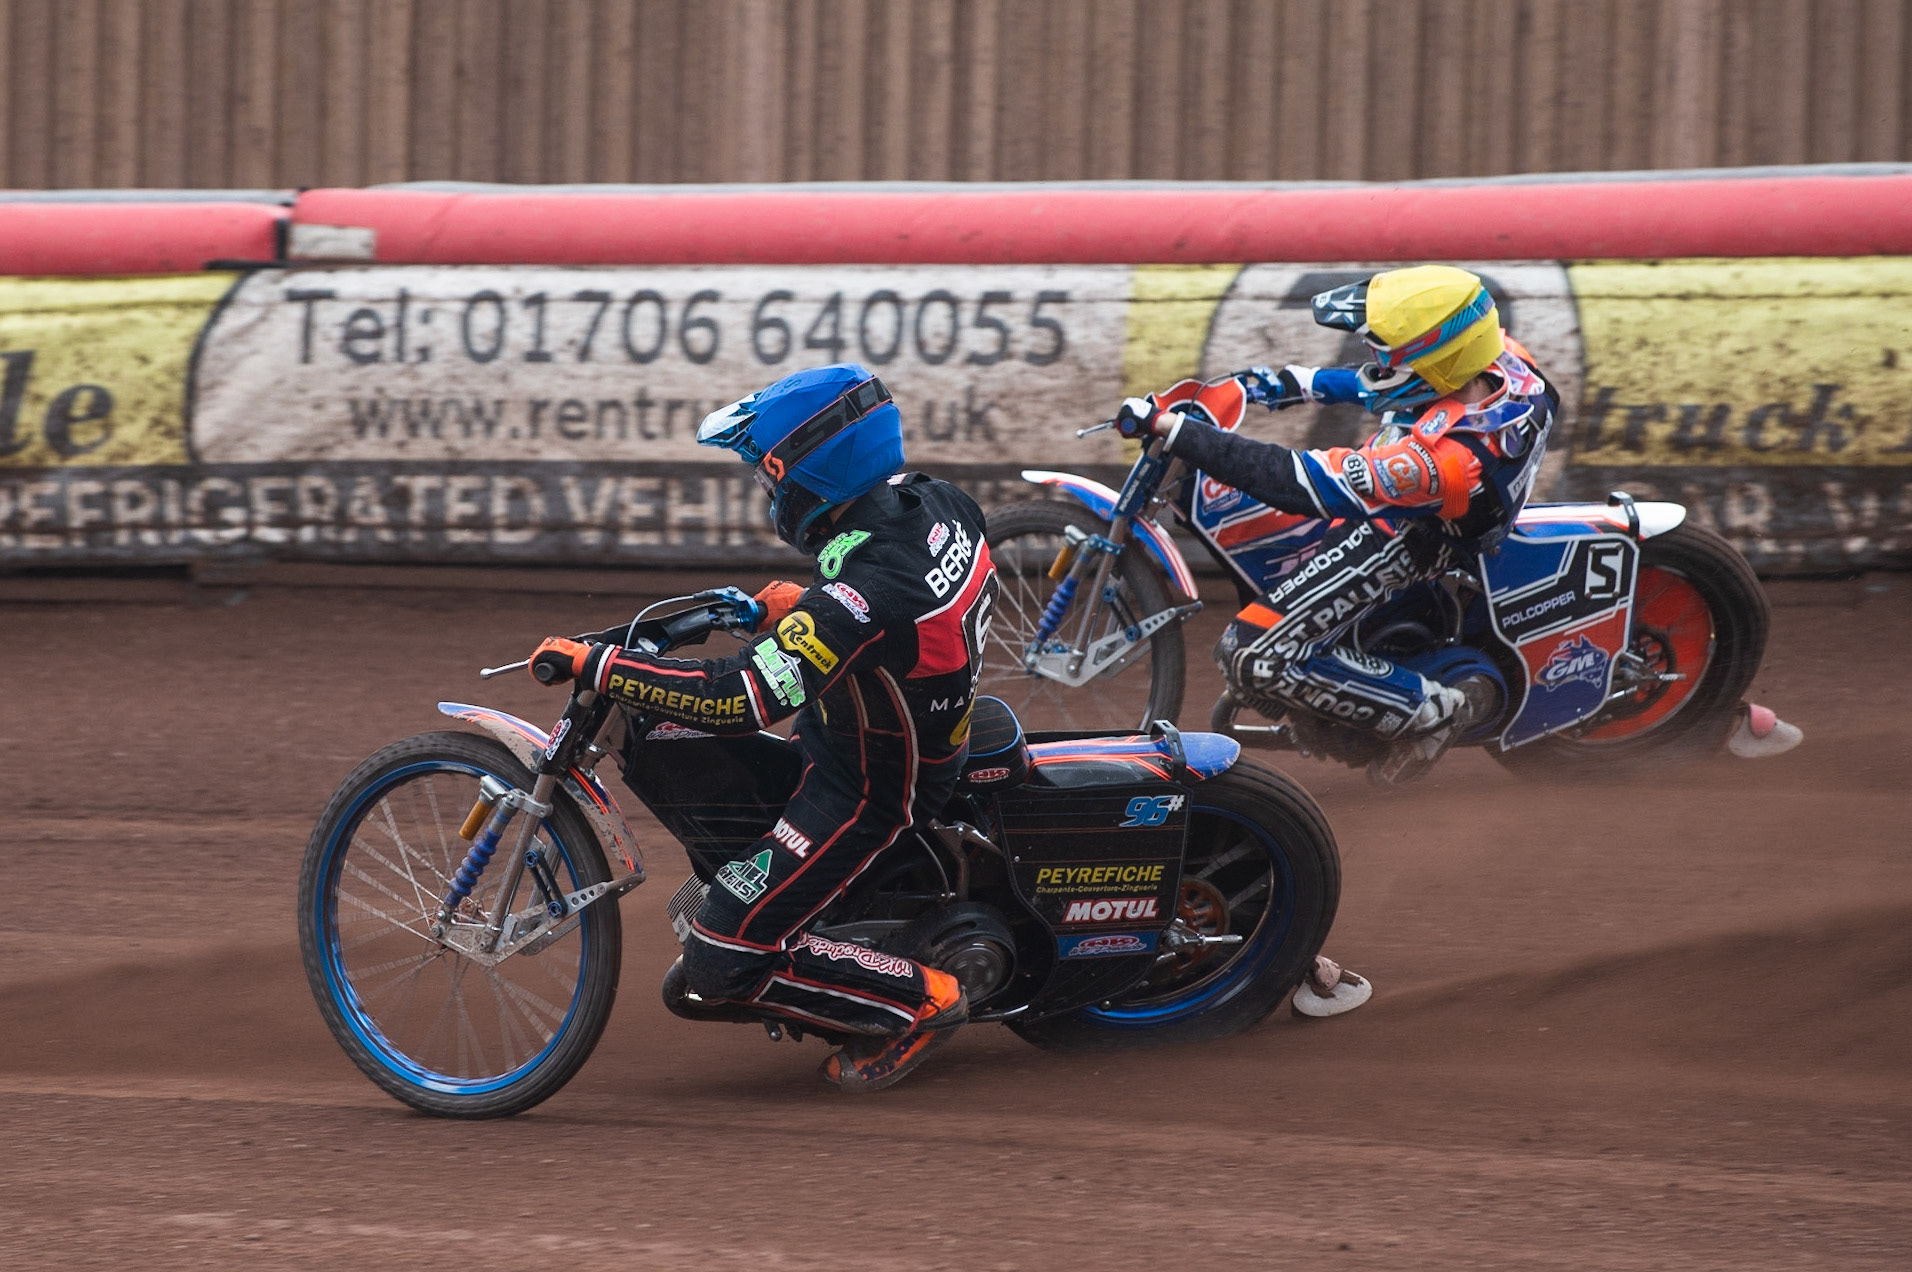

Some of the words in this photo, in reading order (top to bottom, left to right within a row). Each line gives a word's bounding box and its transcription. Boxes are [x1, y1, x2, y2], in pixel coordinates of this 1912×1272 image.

[461, 288, 721, 366] 01706
[751, 288, 1070, 366] 640055
[1268, 521, 1374, 604] POLCOPPER
[1502, 590, 1576, 628] POLCOPPER
[781, 615, 833, 670] Rentruck
[1546, 652, 1595, 681] GM
[608, 673, 748, 716] PEYREFICHE
[1036, 864, 1165, 885] PEYREFICHE
[1064, 899, 1158, 923] MOTUL
